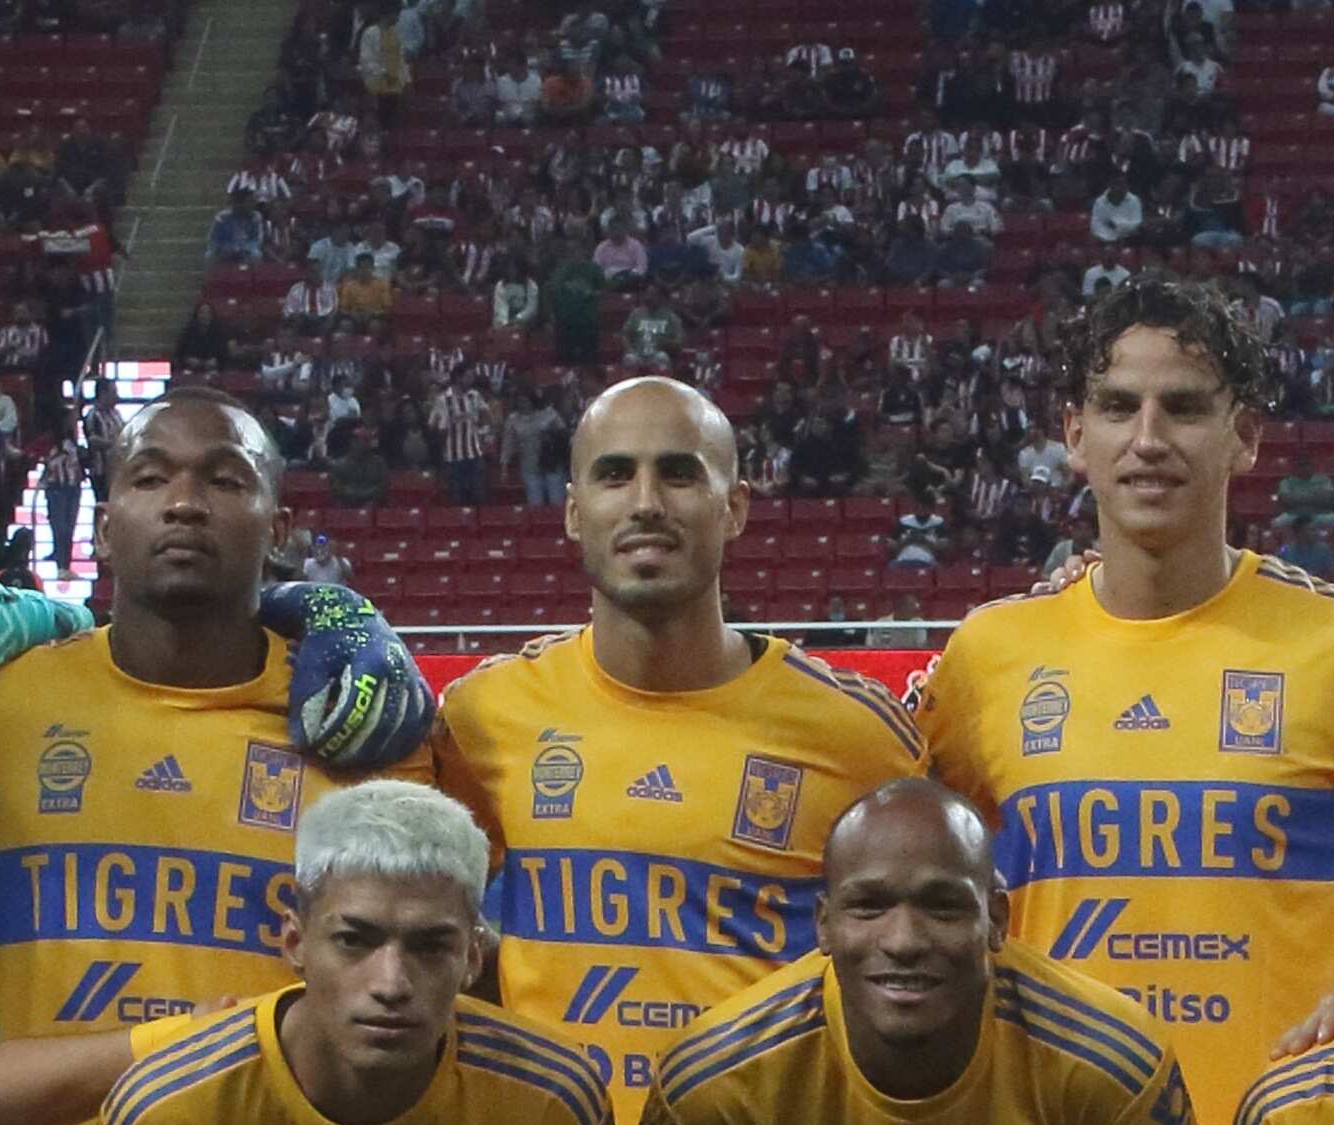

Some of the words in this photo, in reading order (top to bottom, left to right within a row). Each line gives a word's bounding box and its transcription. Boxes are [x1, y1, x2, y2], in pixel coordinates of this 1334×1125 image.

[317, 673, 377, 757] reusch
[1023, 737, 1059, 752] EXTRA
[534, 802, 569, 815] EXTRA
[1017, 787, 1292, 872] TIGRES
[21, 852, 297, 948] TIGRES
[520, 857, 788, 953] TIGRES
[1107, 933, 1250, 961] CEMEX
